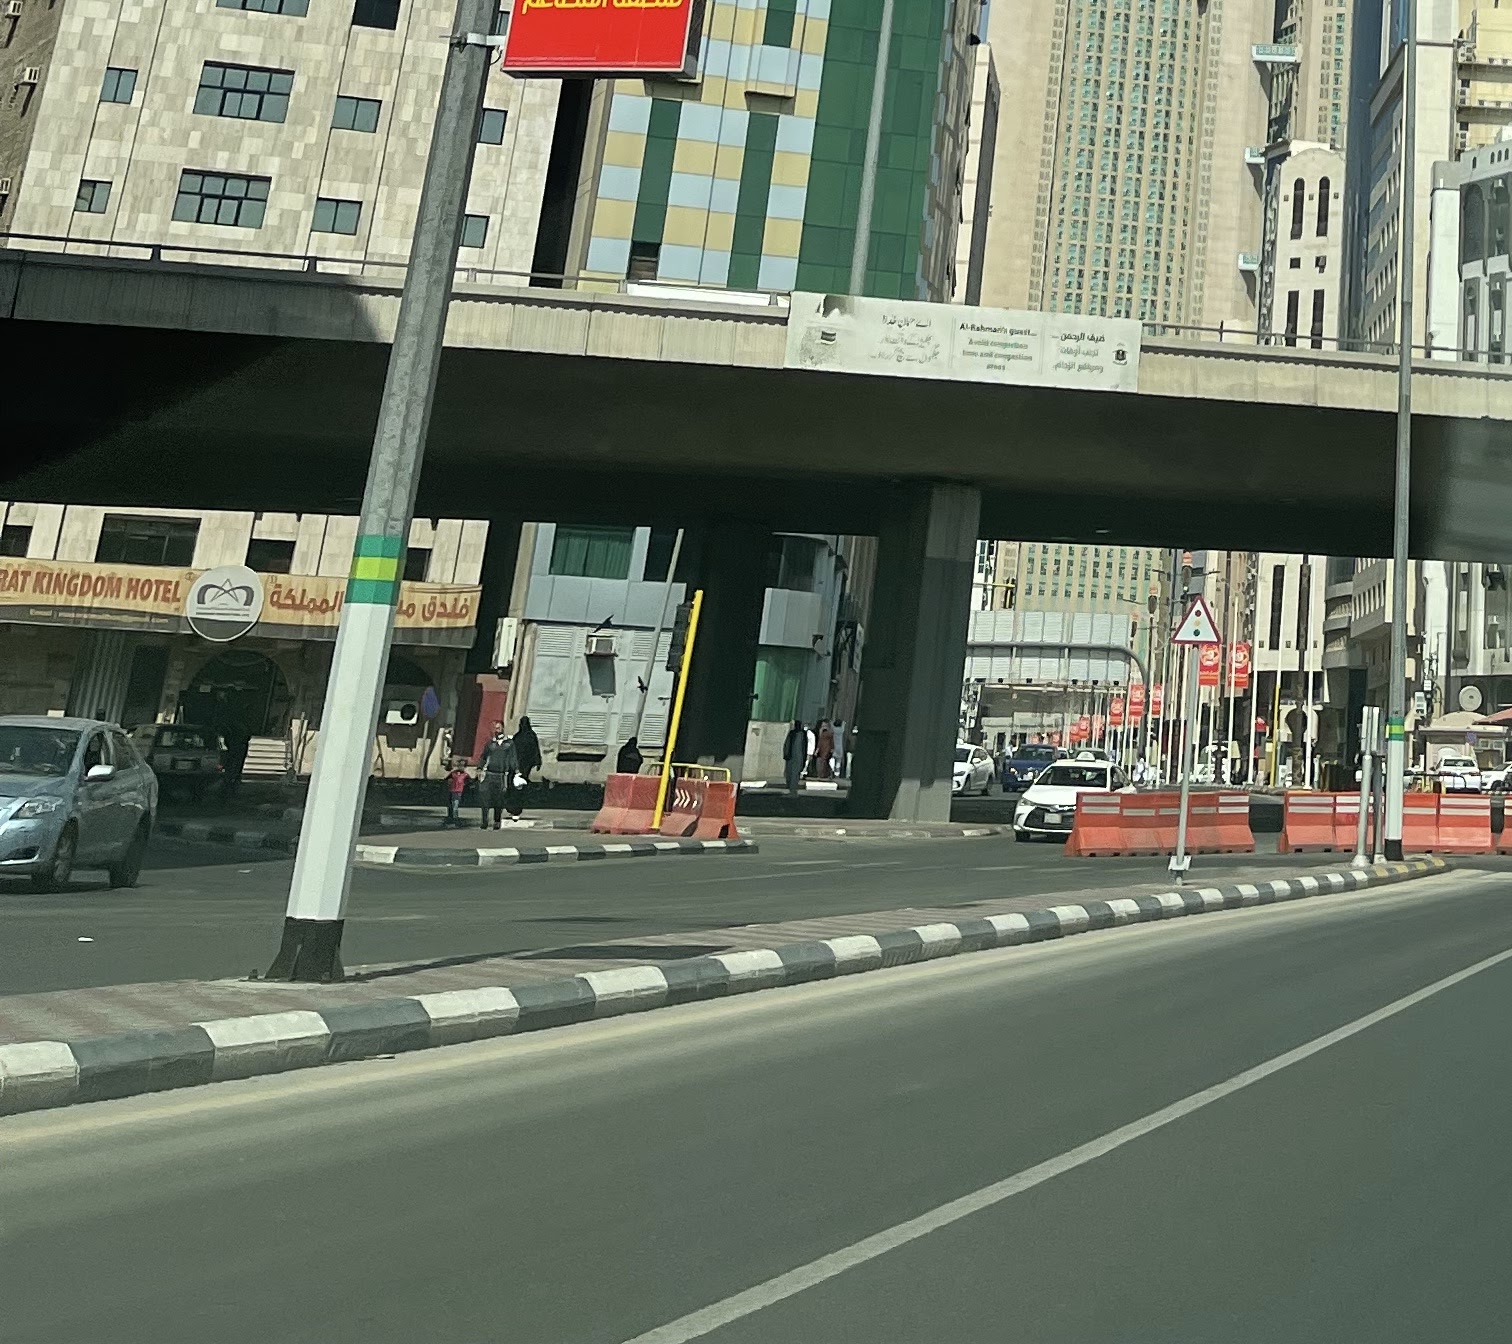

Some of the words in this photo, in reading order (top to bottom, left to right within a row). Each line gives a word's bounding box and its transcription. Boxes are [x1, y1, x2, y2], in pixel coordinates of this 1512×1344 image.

[32, 570, 122, 599] KINGDOM
[125, 577, 181, 603] HOTEL
[270, 584, 345, 613] المملكة
[421, 595, 470, 622] فندق
